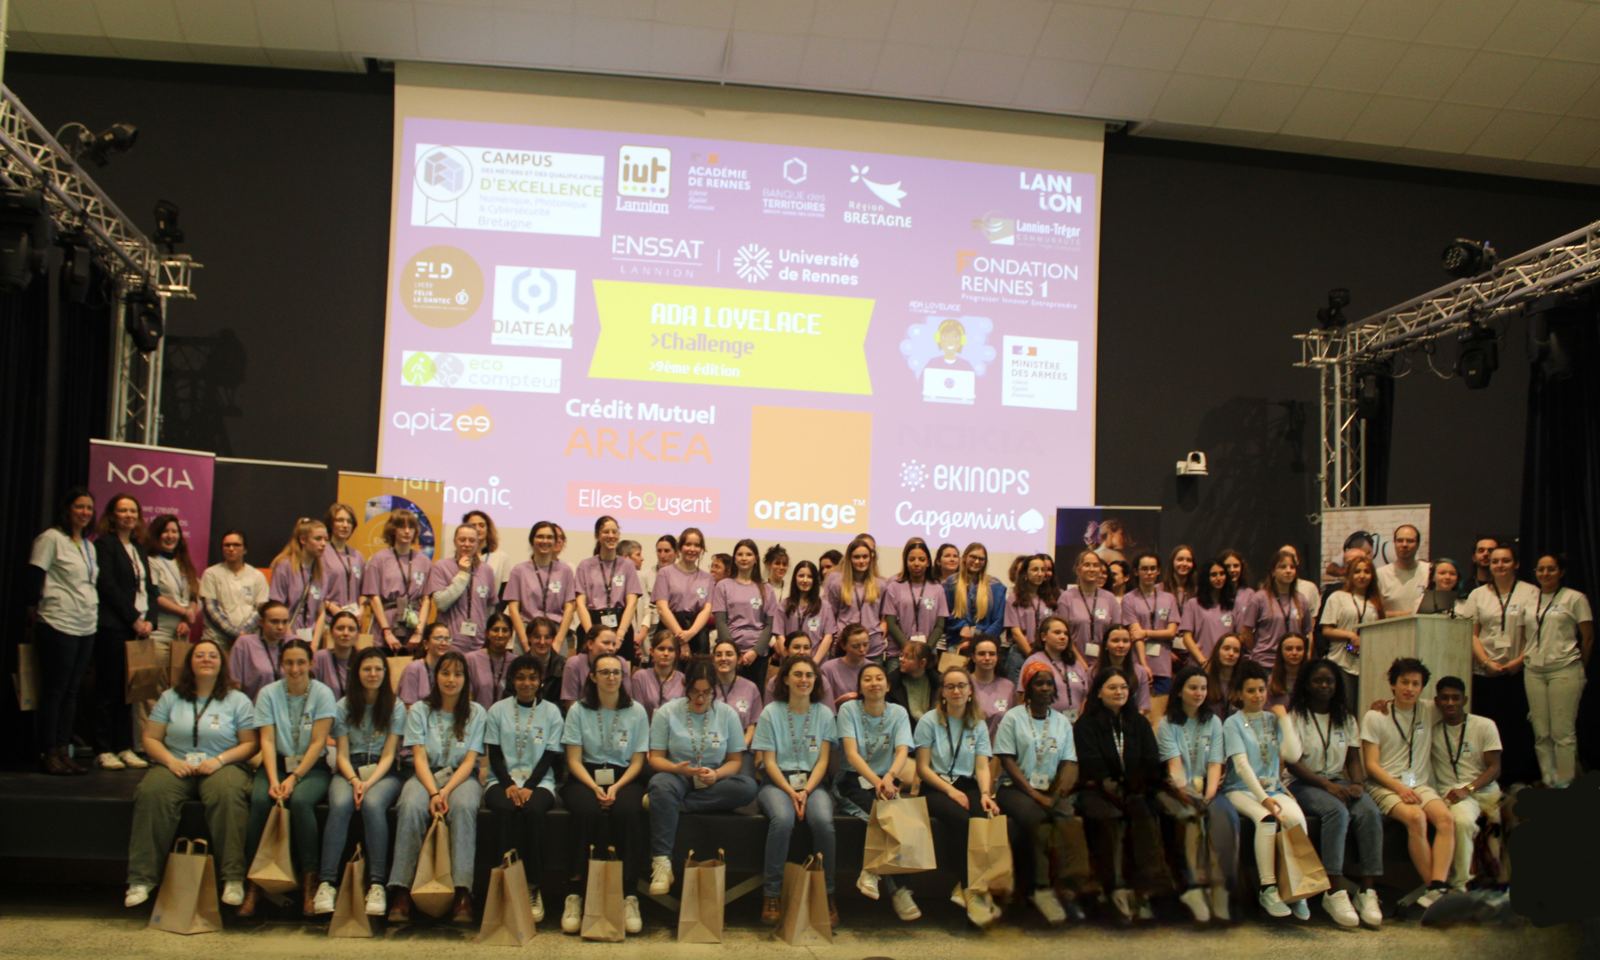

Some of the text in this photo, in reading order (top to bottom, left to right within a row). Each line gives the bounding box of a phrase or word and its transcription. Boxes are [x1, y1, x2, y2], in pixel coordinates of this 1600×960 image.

[480, 150, 553, 168] CAMPUS
[688, 165, 749, 180] ACADÉMIE
[480, 178, 604, 199] D'EXCELLENCE
[687, 177, 752, 191] DE RENNES
[615, 195, 670, 215] Lannion
[762, 198, 826, 213] TERRITOIRES
[611, 234, 705, 260] ENSSAT
[779, 248, 860, 269] Université
[414, 261, 454, 280] FLD
[619, 263, 695, 279] LANNION
[779, 268, 859, 287] de Rennes
[961, 274, 1049, 298] RENNES 1
[491, 318, 574, 338] DIATEAM
[650, 302, 823, 336] ADA LOVELACE
[468, 358, 503, 371] eco
[693, 363, 741, 380] édition
[1010, 369, 1029, 379] DES
[468, 372, 561, 390] compteur
[392, 407, 491, 436] apizee
[565, 398, 716, 425] Crédit Mutuel
[563, 426, 714, 465] ARKEA
[107, 461, 195, 491] NOKIA
[578, 488, 713, 517] Elles bougent
[753, 499, 857, 532] orange
[895, 500, 1018, 539] Capgemini
